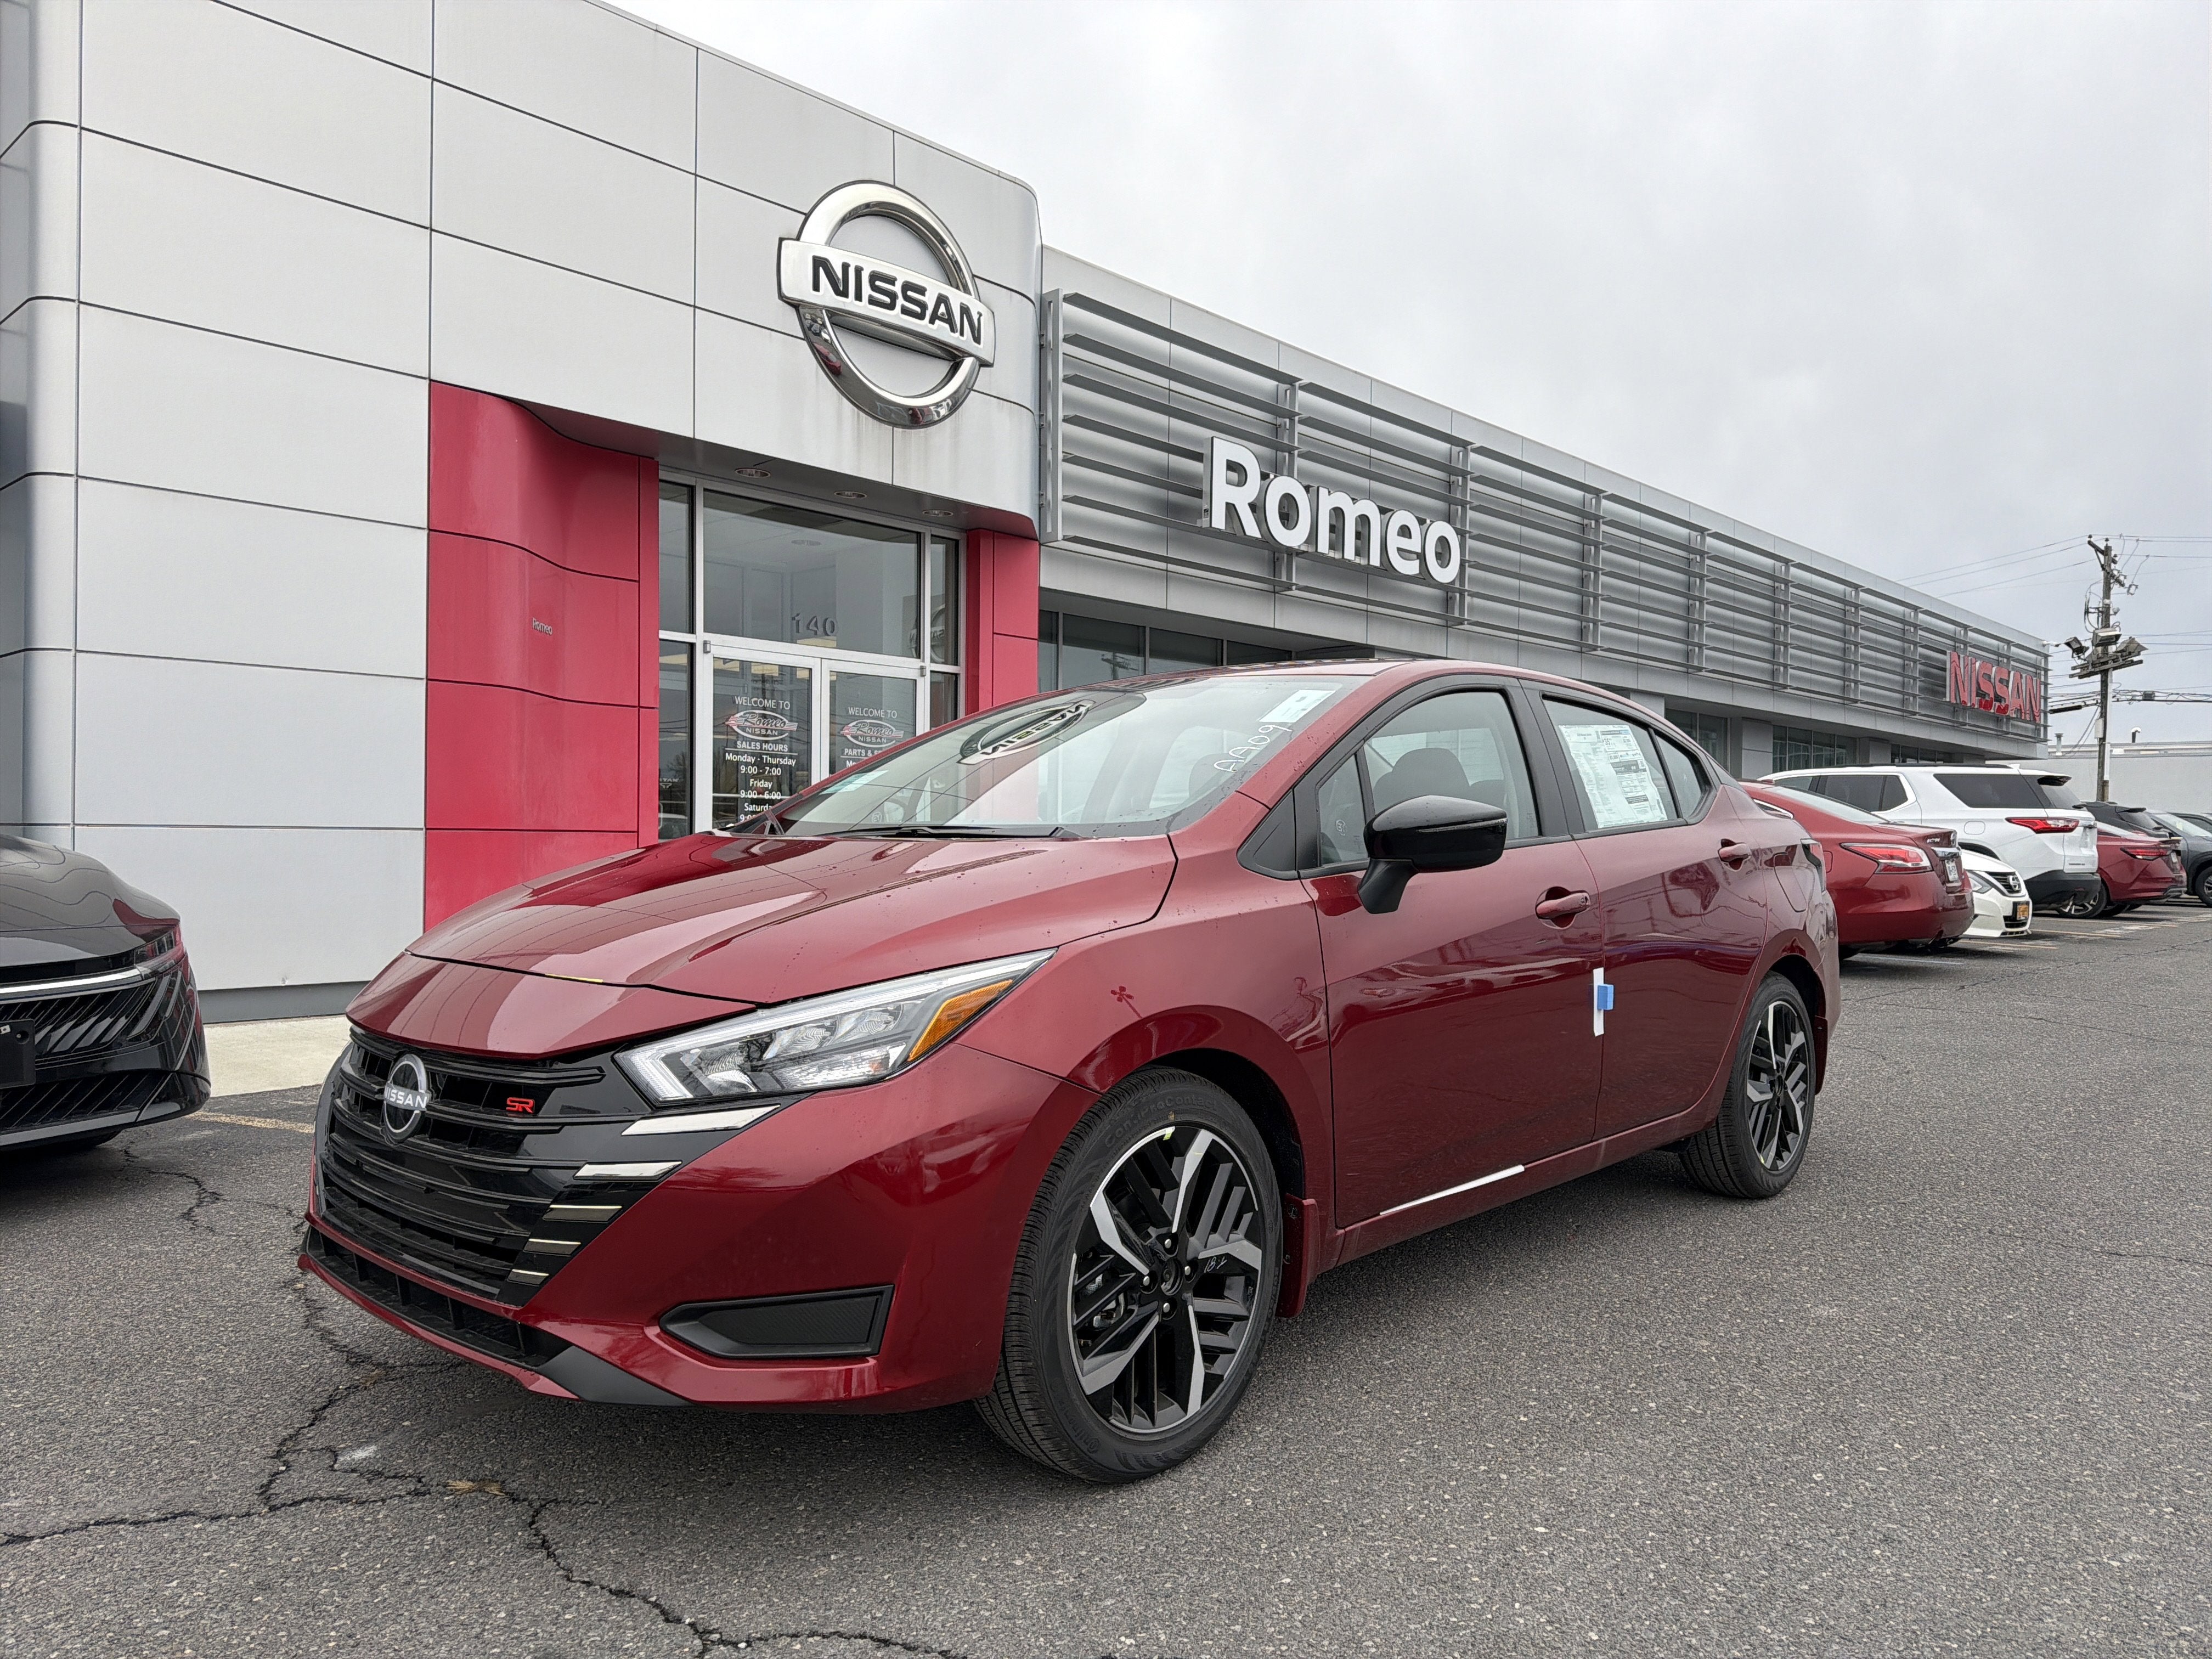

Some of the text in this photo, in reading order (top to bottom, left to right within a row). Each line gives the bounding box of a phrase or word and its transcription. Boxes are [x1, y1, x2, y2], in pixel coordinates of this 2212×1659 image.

[812, 255, 983, 345] NISSAN
[1210, 436, 1461, 584] Romeo
[532, 617, 552, 635] Romeo
[791, 612, 838, 636] 140
[1948, 651, 2041, 723] NISSAN
[735, 696, 791, 710] WELCOME TO
[738, 712, 786, 728] Romeo
[848, 707, 898, 719] WELCOME TO
[736, 741, 788, 752] SALES HOURS
[725, 753, 755, 764] Monday
[762, 755, 796, 767] Thursday
[740, 765, 758, 774] 9:00
[765, 767, 781, 775] 7:00
[749, 779, 772, 789] Friday
[740, 790, 757, 798] 9:00
[764, 791, 781, 799] 6:00
[744, 803, 772, 811] Saturda
[385, 1086, 428, 1109] NISSAN
[506, 1097, 535, 1113] SR
